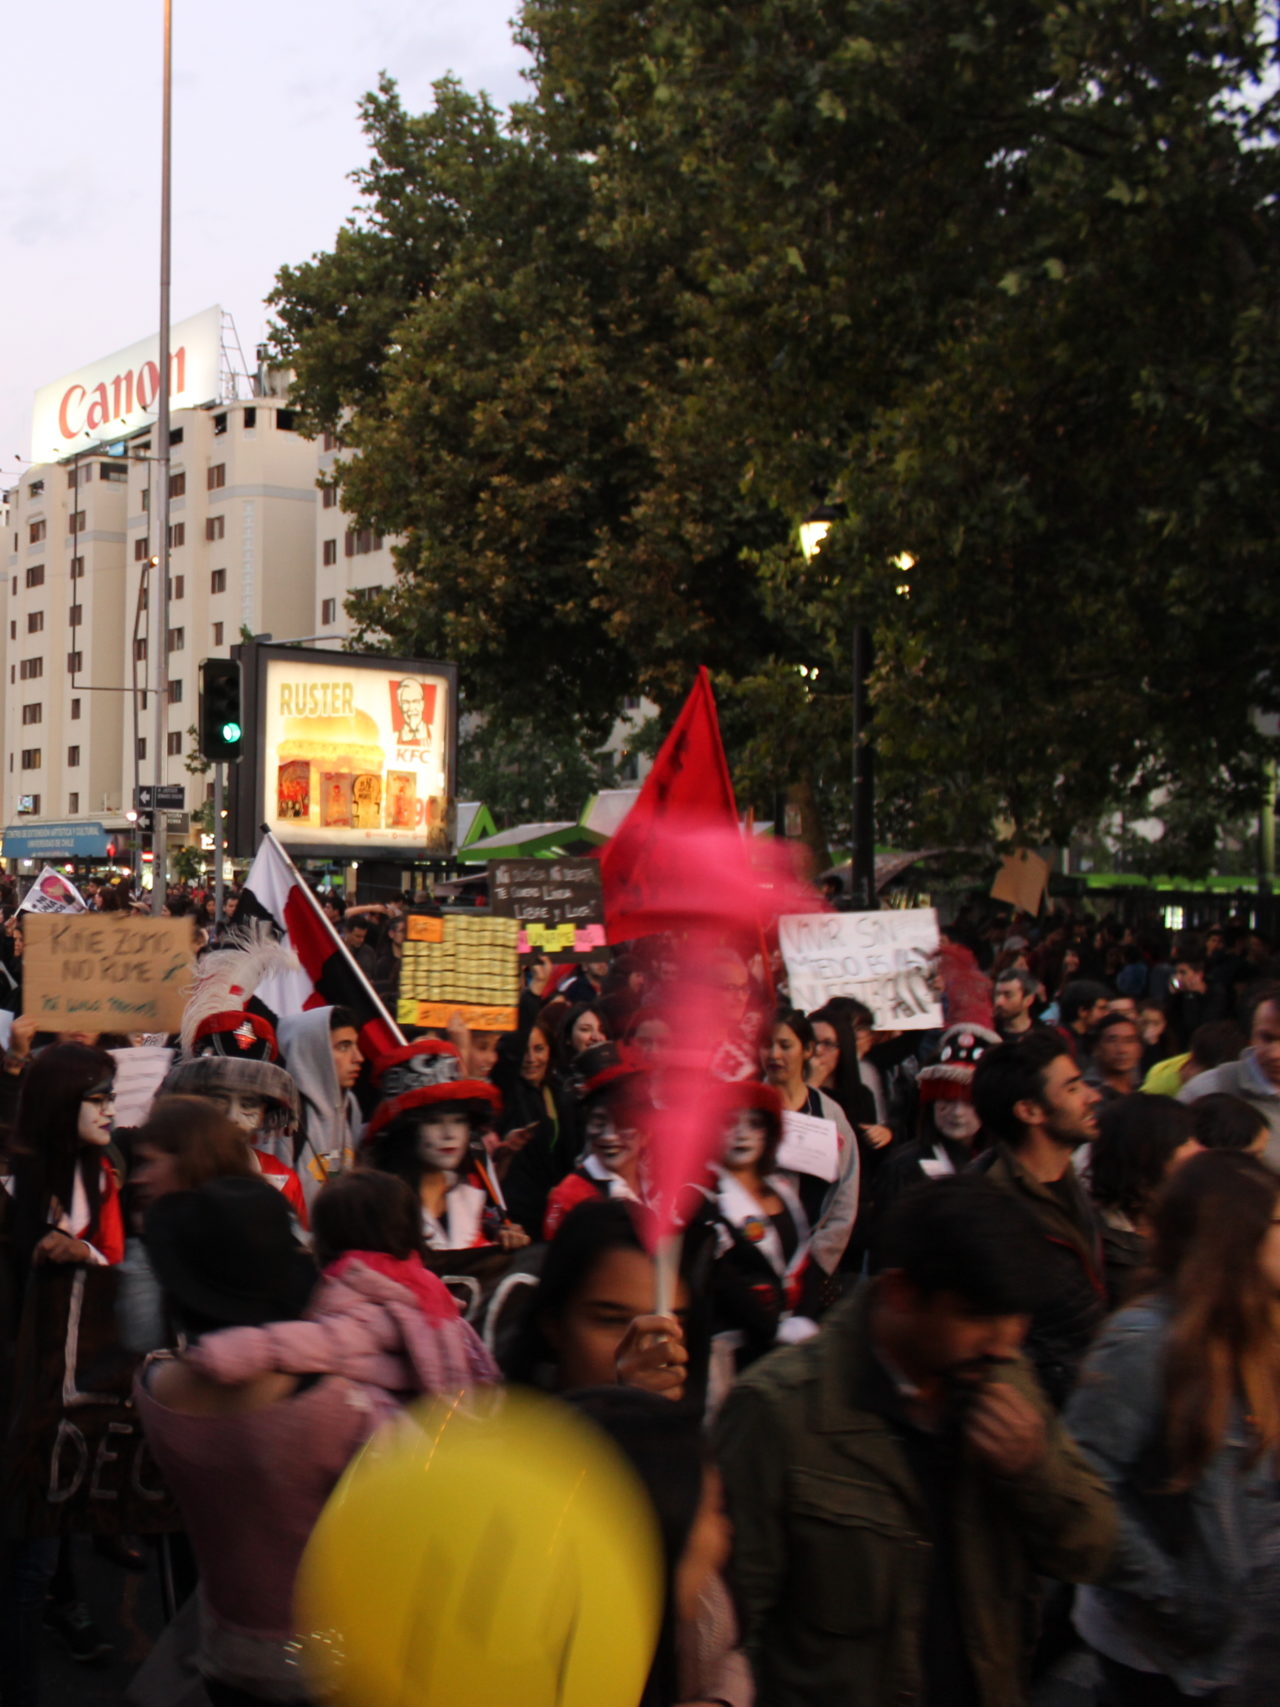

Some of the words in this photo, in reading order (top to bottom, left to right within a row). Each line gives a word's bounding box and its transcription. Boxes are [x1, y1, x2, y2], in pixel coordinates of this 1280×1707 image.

[59, 346, 185, 439] Canon
[279, 682, 354, 716] RUSTER
[396, 748, 431, 764] KFC
